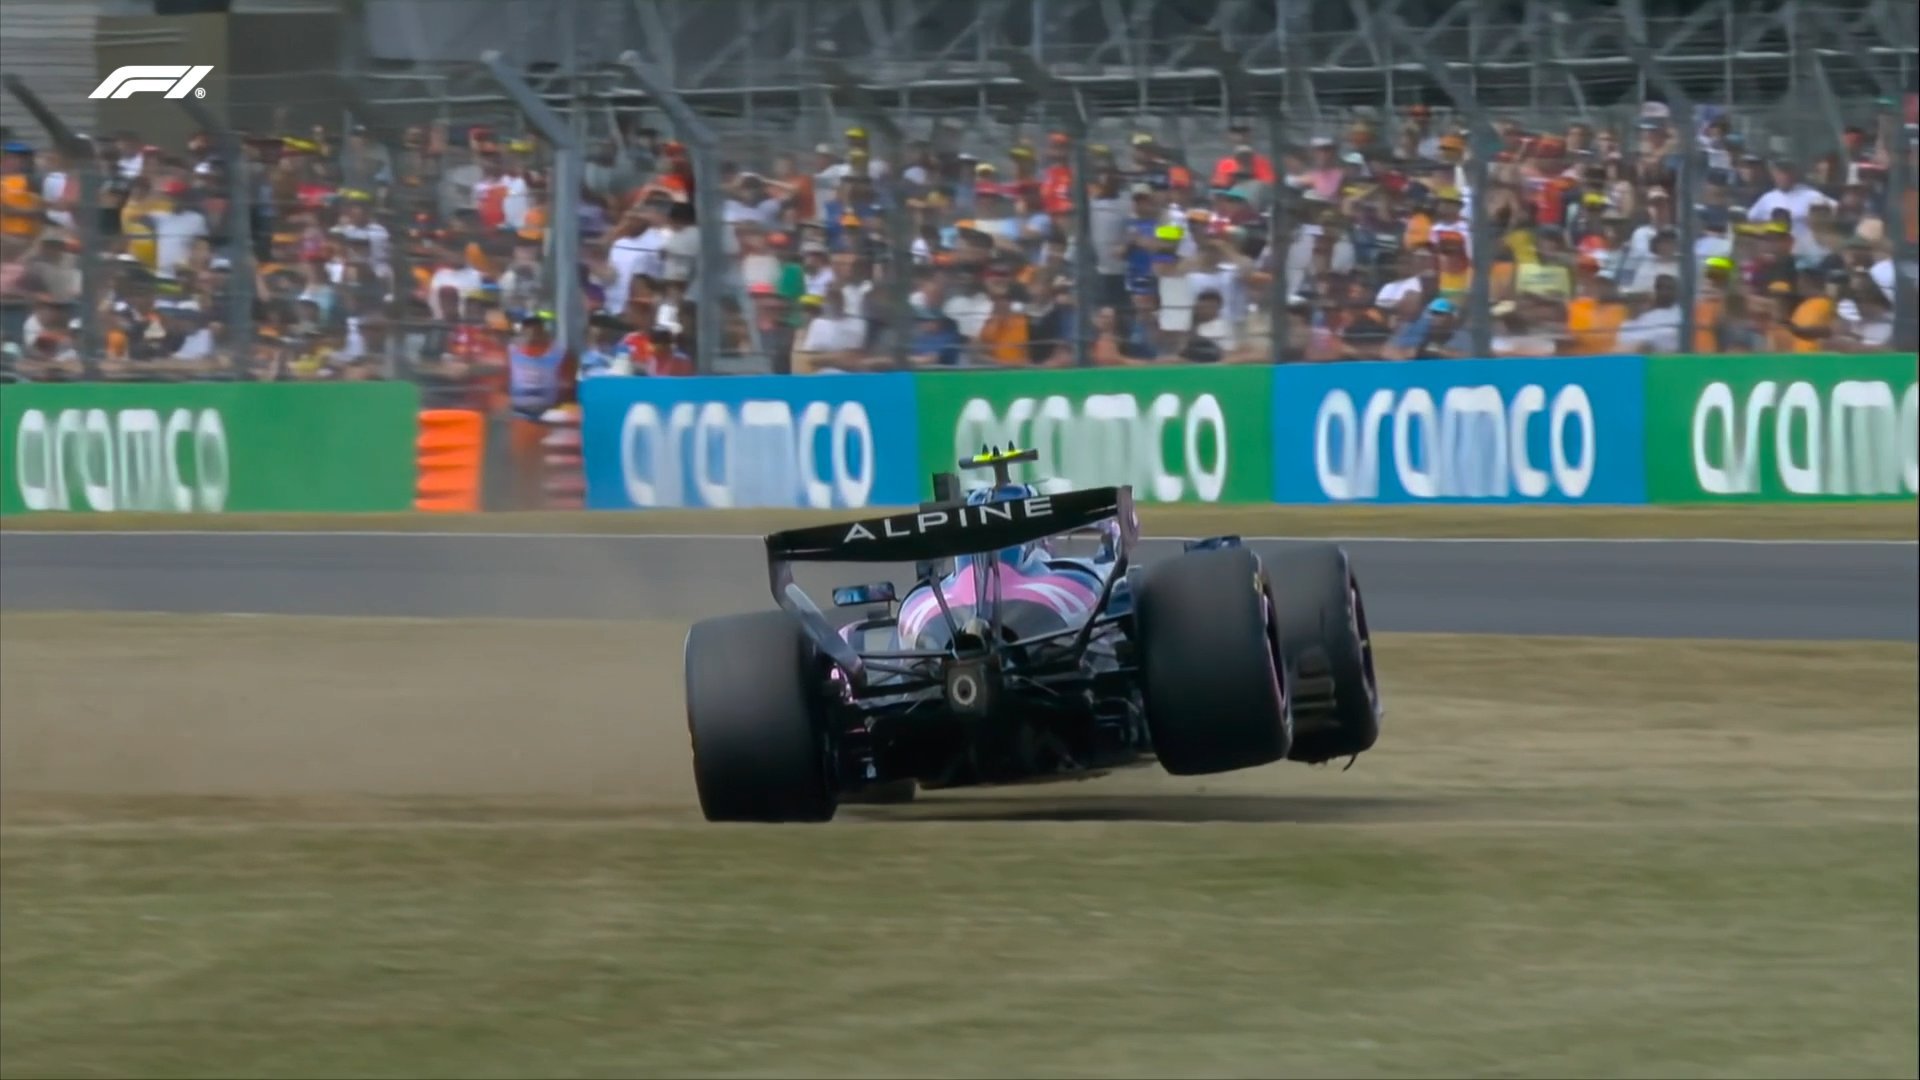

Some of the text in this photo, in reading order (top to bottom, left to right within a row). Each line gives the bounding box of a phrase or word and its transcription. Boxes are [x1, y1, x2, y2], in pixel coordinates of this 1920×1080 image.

[17, 408, 229, 512] aramco
[621, 400, 872, 508] aramco
[954, 393, 1227, 502] aramco
[1315, 384, 1595, 499] aramco
[843, 497, 1053, 543] ALPINE
